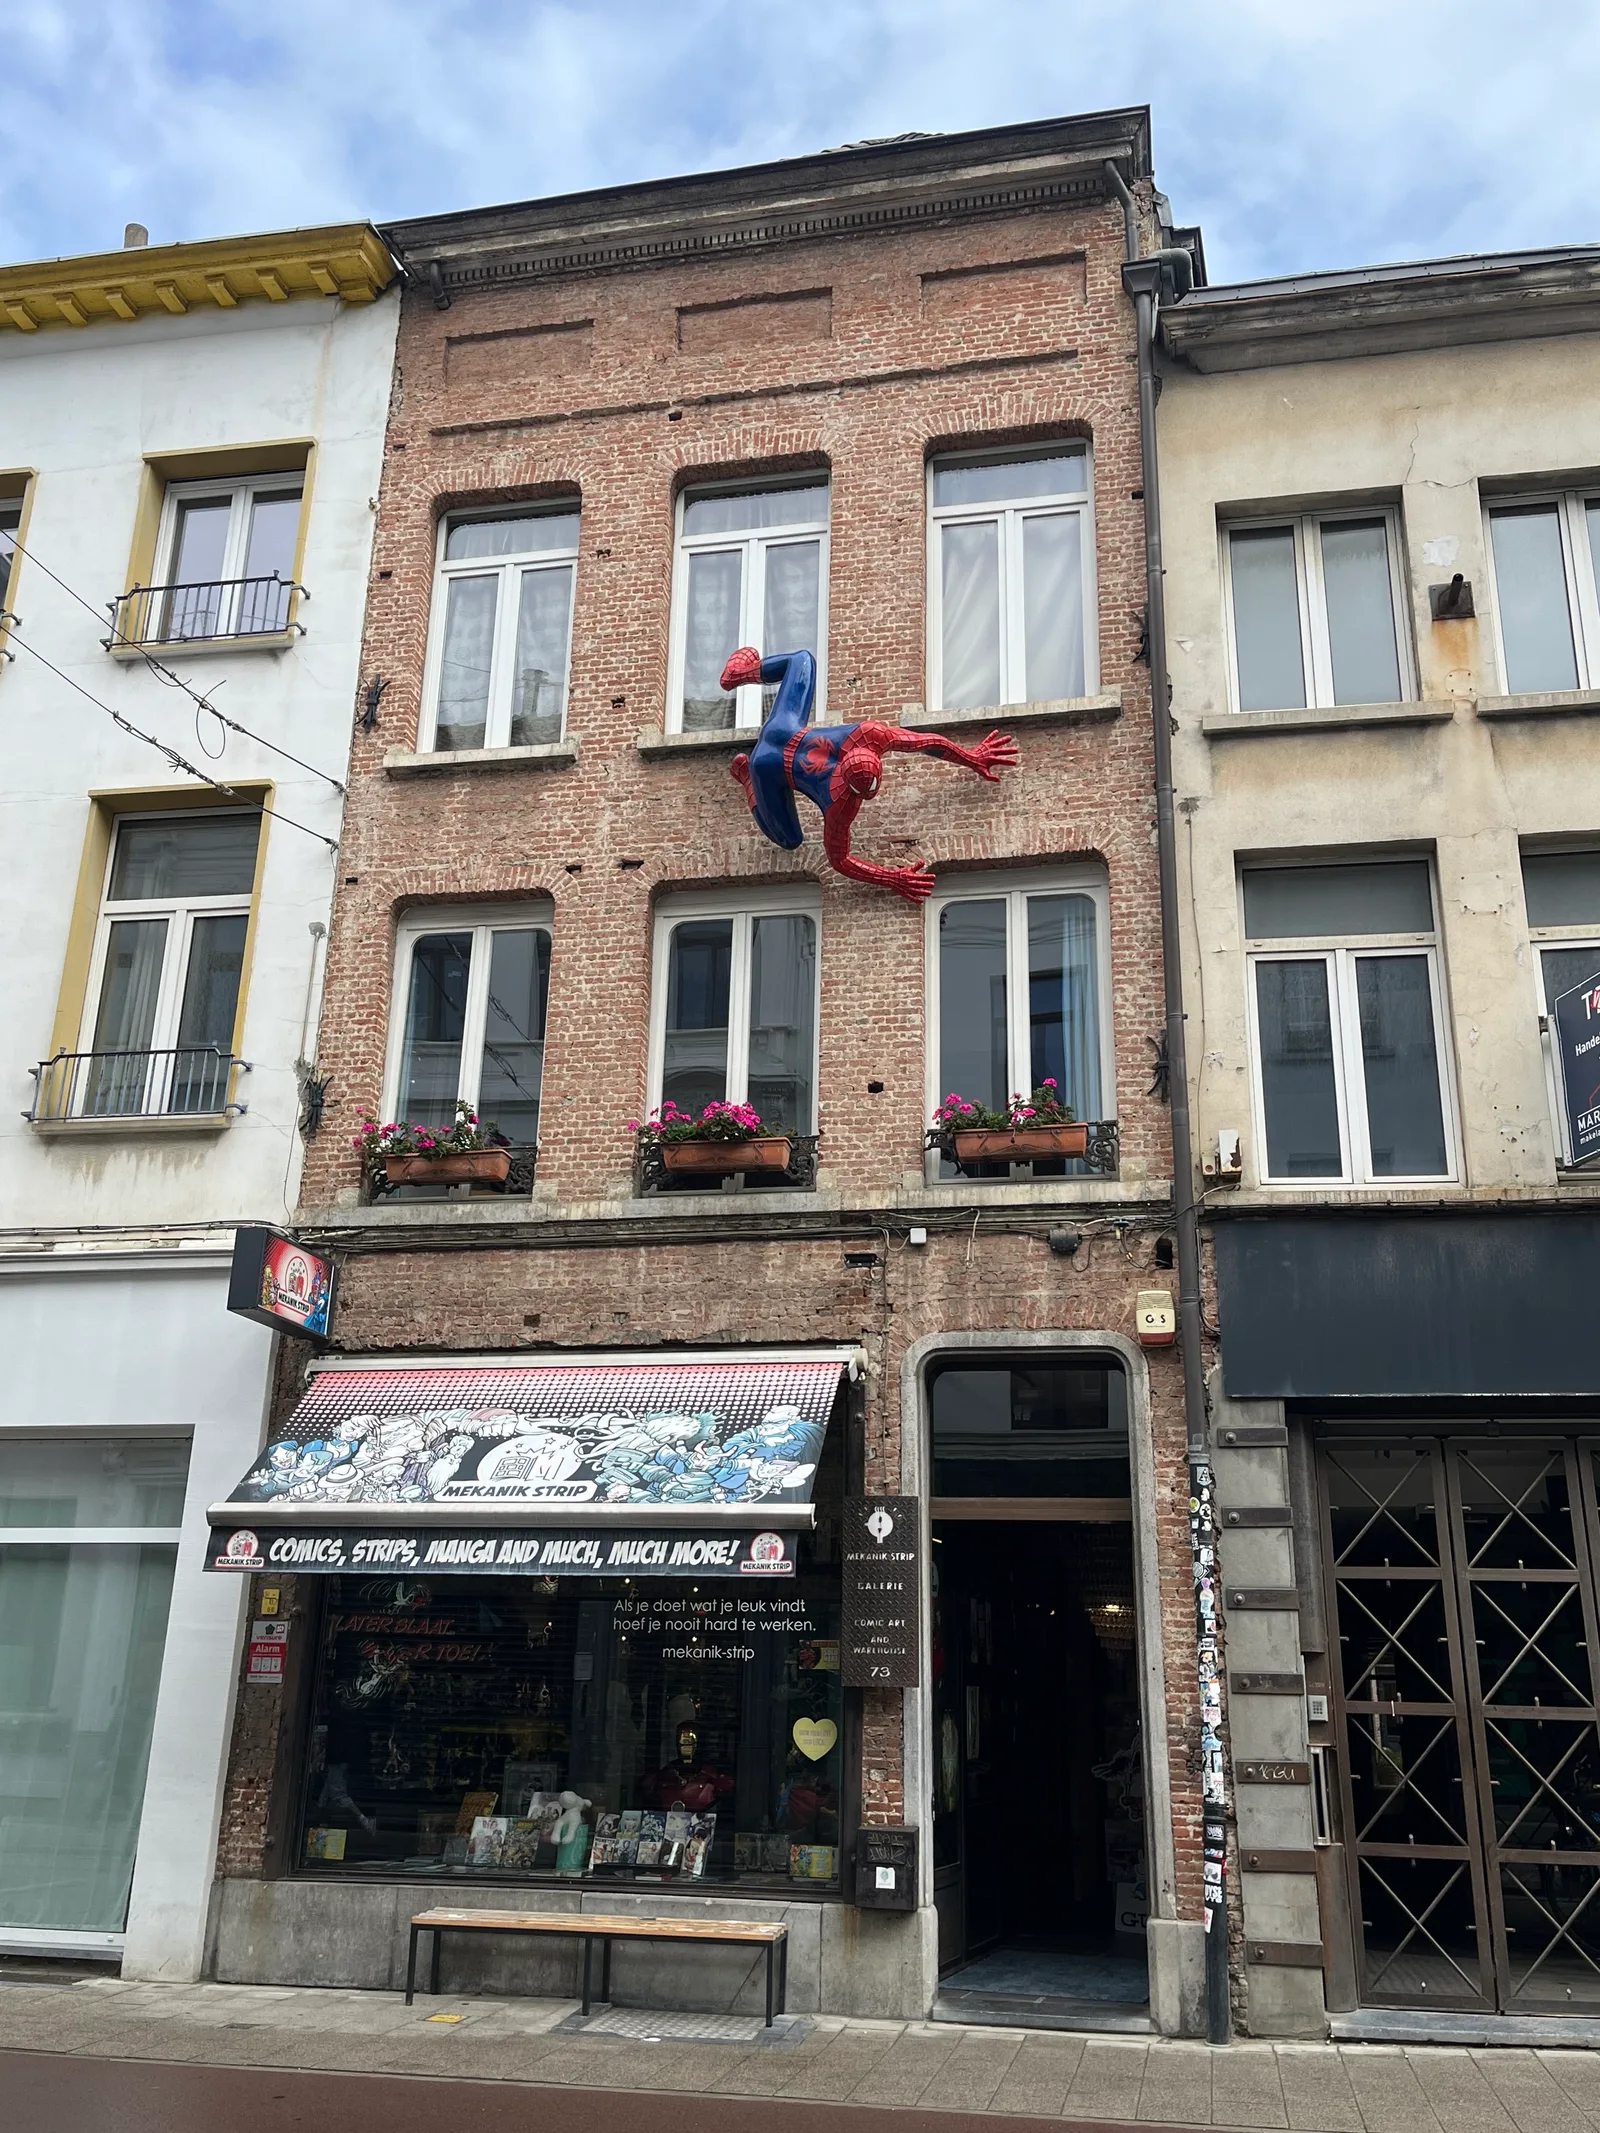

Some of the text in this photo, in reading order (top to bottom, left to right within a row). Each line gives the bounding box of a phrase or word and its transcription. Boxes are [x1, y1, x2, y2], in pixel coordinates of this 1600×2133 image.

[1575, 1033, 1600, 1057] Hande
[278, 1292, 298, 1308] MEKANIK
[442, 1485, 588, 1497] MEKANIK STRIP
[269, 1537, 741, 1569] COMICS, STRIPS, MANGA AND MUCH, MUCH MORE!
[847, 1552, 915, 1561] MEKANIK STRIP
[218, 1558, 263, 1567] MEKANIK STRIP
[743, 1562, 791, 1570] MEKANIK STRIP
[857, 1582, 904, 1591] GALERIE
[614, 1599, 806, 1615] Als je doet wat je leuk vindt
[613, 1617, 816, 1633] hoef je nooit hard te werken.
[854, 1619, 906, 1628] COMIC ART
[870, 1636, 889, 1644] AND
[255, 1644, 280, 1653] Alarm
[662, 1645, 755, 1662] mekanik-strip
[870, 1666, 891, 1678] 73
